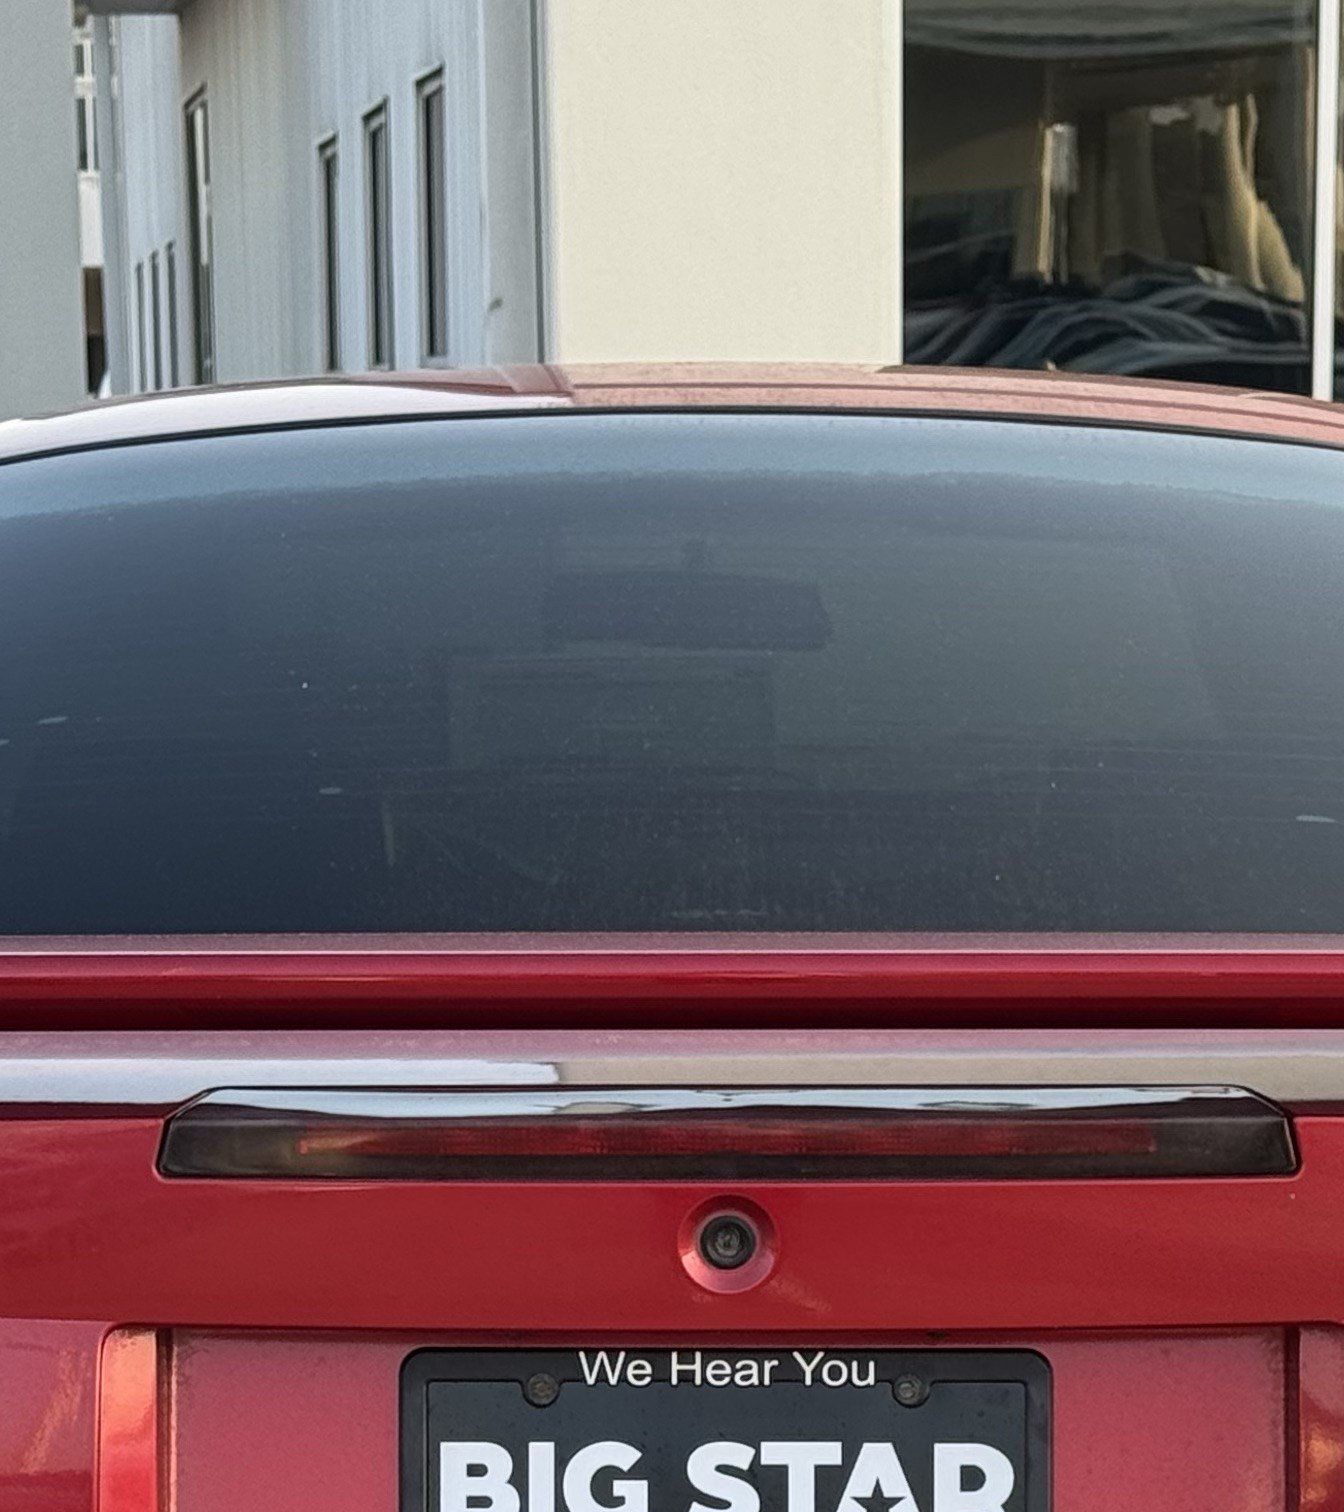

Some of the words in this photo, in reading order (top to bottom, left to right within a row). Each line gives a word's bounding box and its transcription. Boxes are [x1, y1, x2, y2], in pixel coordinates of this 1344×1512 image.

[578, 1350, 653, 1386] We
[671, 1350, 779, 1387] Hear
[792, 1350, 876, 1387] You
